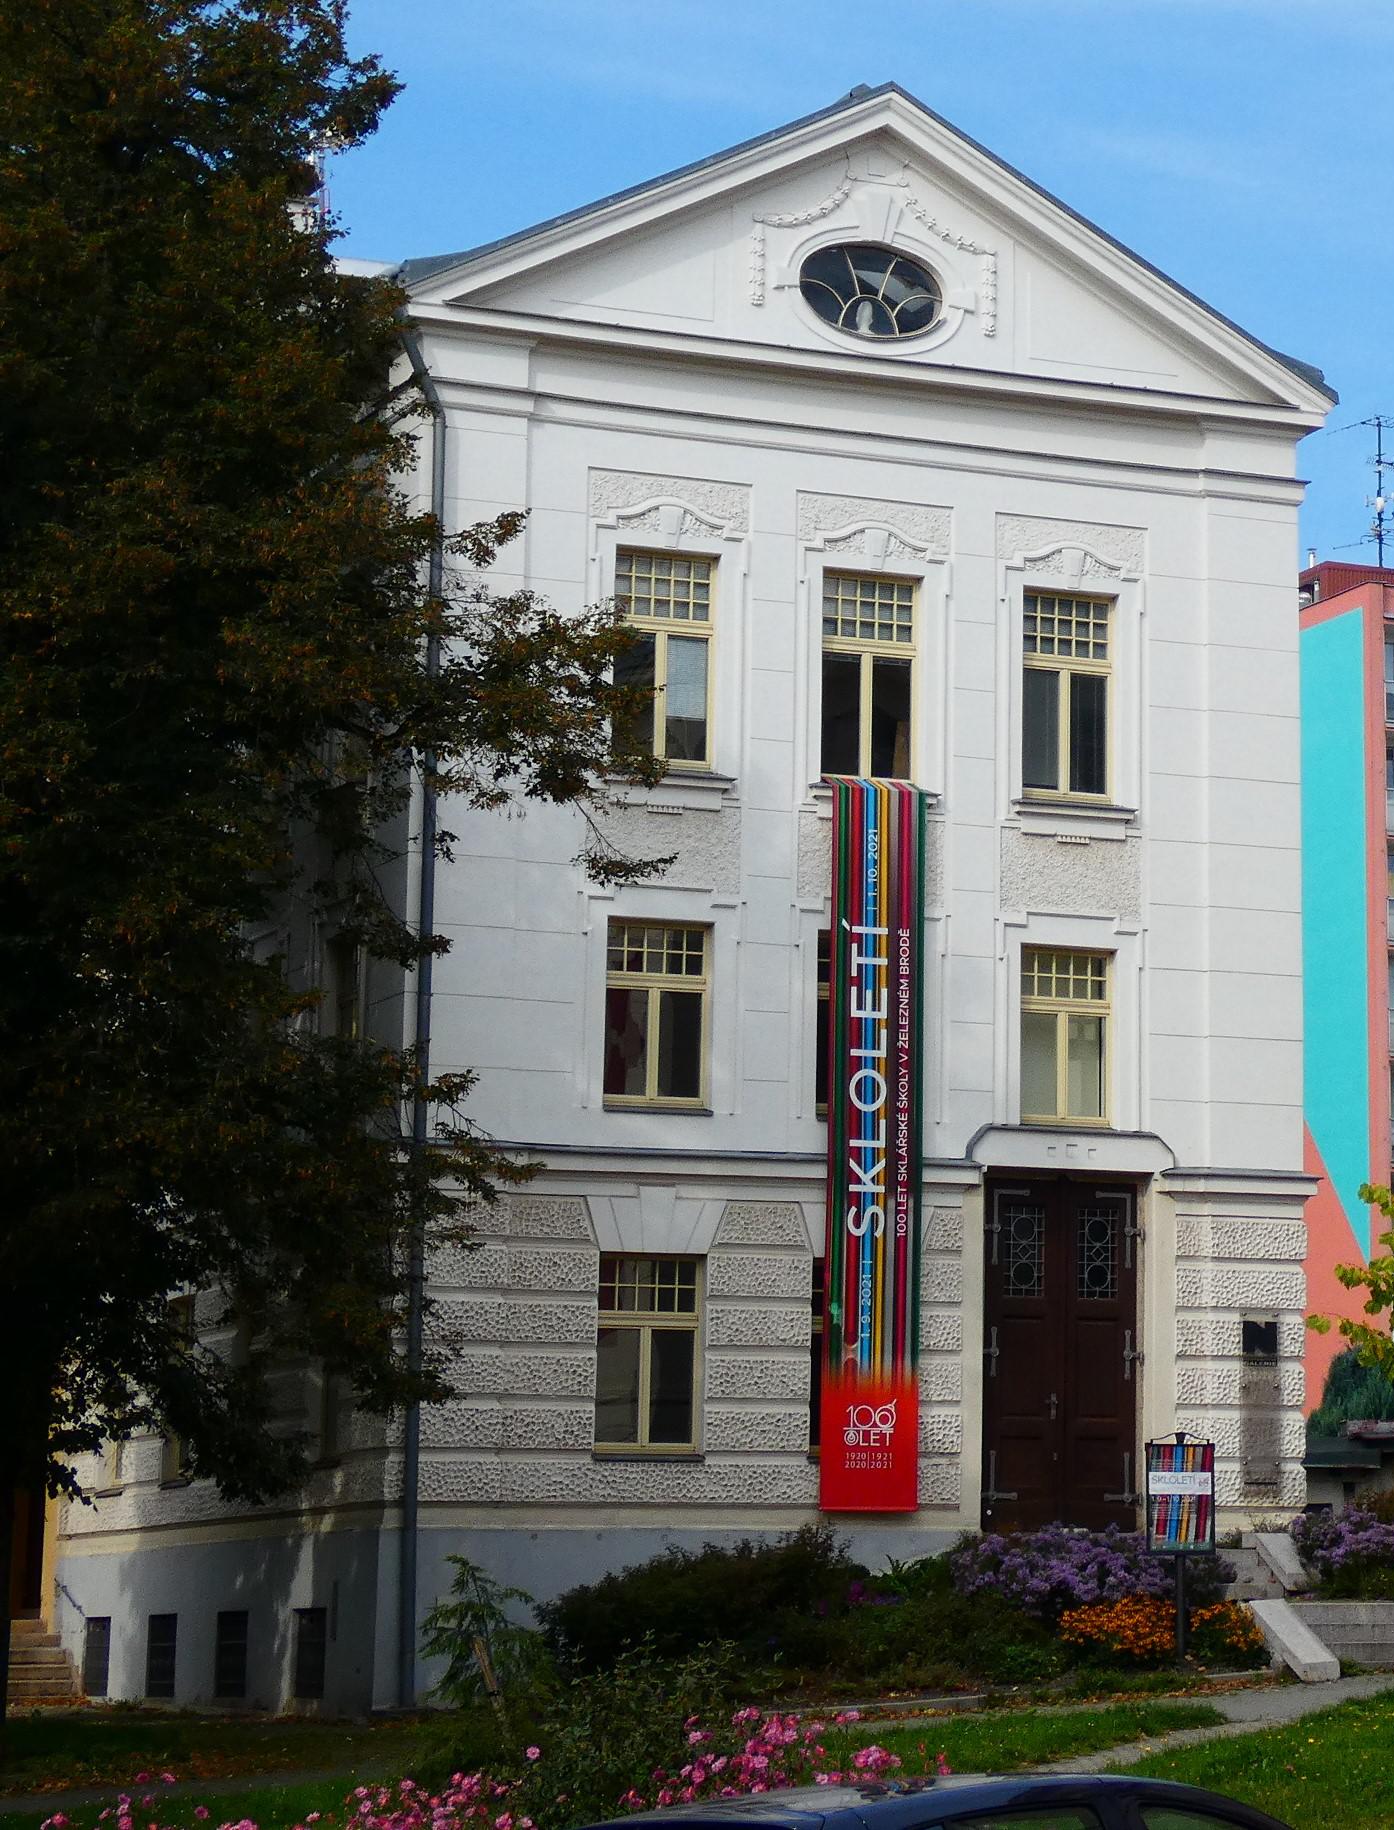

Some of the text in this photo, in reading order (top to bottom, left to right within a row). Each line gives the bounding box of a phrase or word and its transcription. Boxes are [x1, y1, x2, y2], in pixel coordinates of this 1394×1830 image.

[867, 829, 878, 860] 2021
[842, 917, 889, 1238] SKLOLETÍ
[895, 928, 910, 1237] 100 LET SKLÁŘSKÉ ŠKOLY V ŽELEZNÉM BRODĚ
[861, 1274, 872, 1306] 2021
[844, 1461, 893, 1469] 2020 2021
[845, 1452, 893, 1460] 1920 1921
